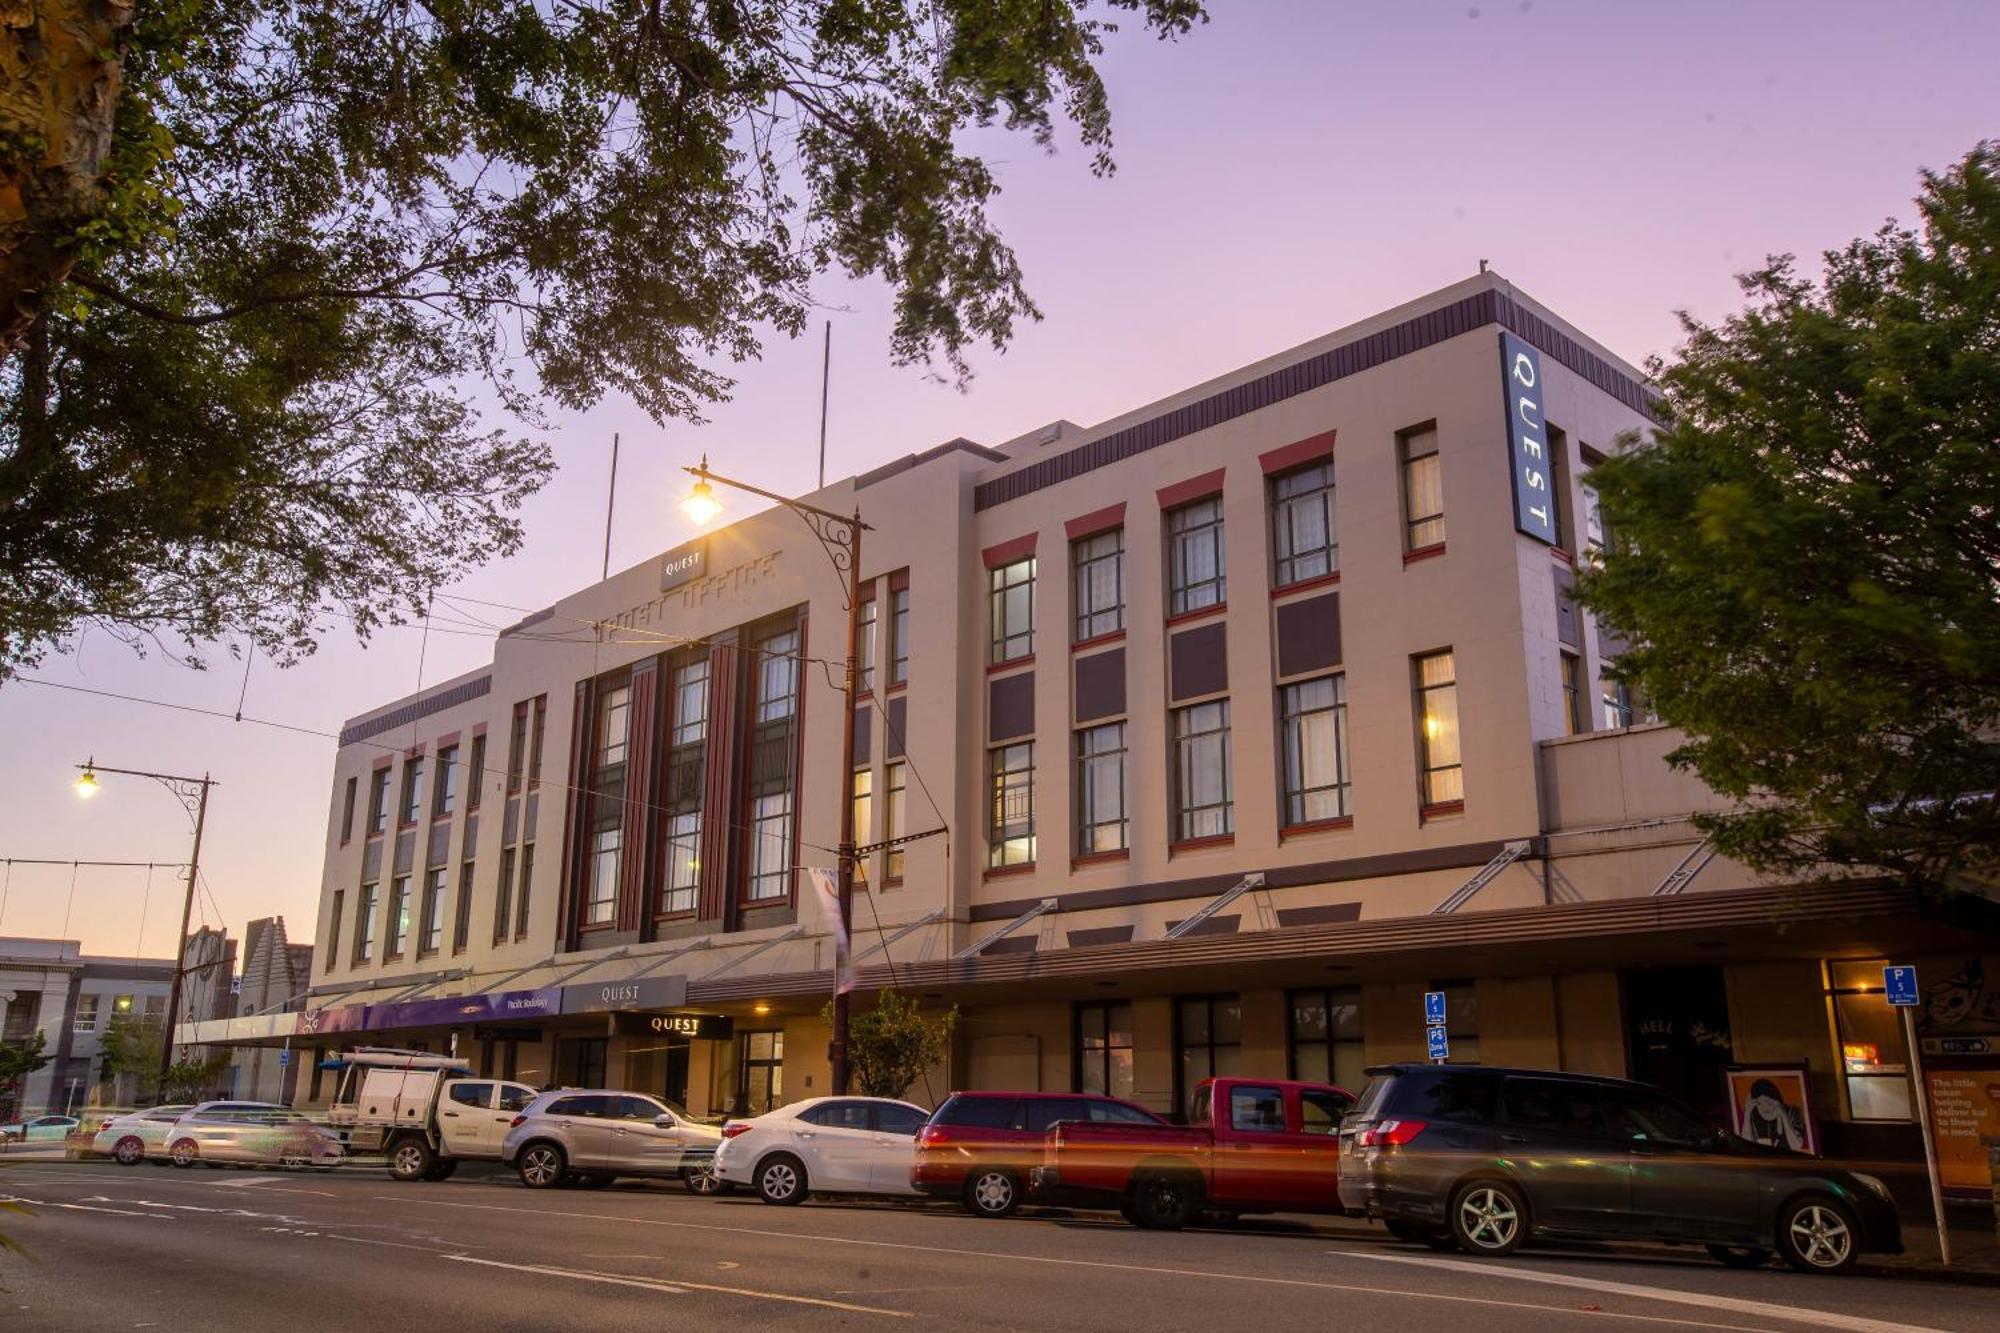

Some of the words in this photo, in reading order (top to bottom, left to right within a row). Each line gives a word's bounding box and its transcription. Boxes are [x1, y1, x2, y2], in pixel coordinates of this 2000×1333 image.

[1513, 352, 1548, 527] QUEST
[666, 553, 700, 576] QUEST
[1894, 968, 1904, 981] P
[1897, 982, 1904, 992] 5
[602, 986, 639, 1003] QUEST
[1431, 995, 1438, 1004] P
[651, 1017, 699, 1033] QUEST
[1638, 1019, 1672, 1035] HELL
[1931, 1079, 1951, 1088] The
[1953, 1079, 1976, 1088] little
[1936, 1108, 1969, 1117] deliver
[1937, 1118, 1949, 1126] to
[1939, 1127, 1949, 1136] in
